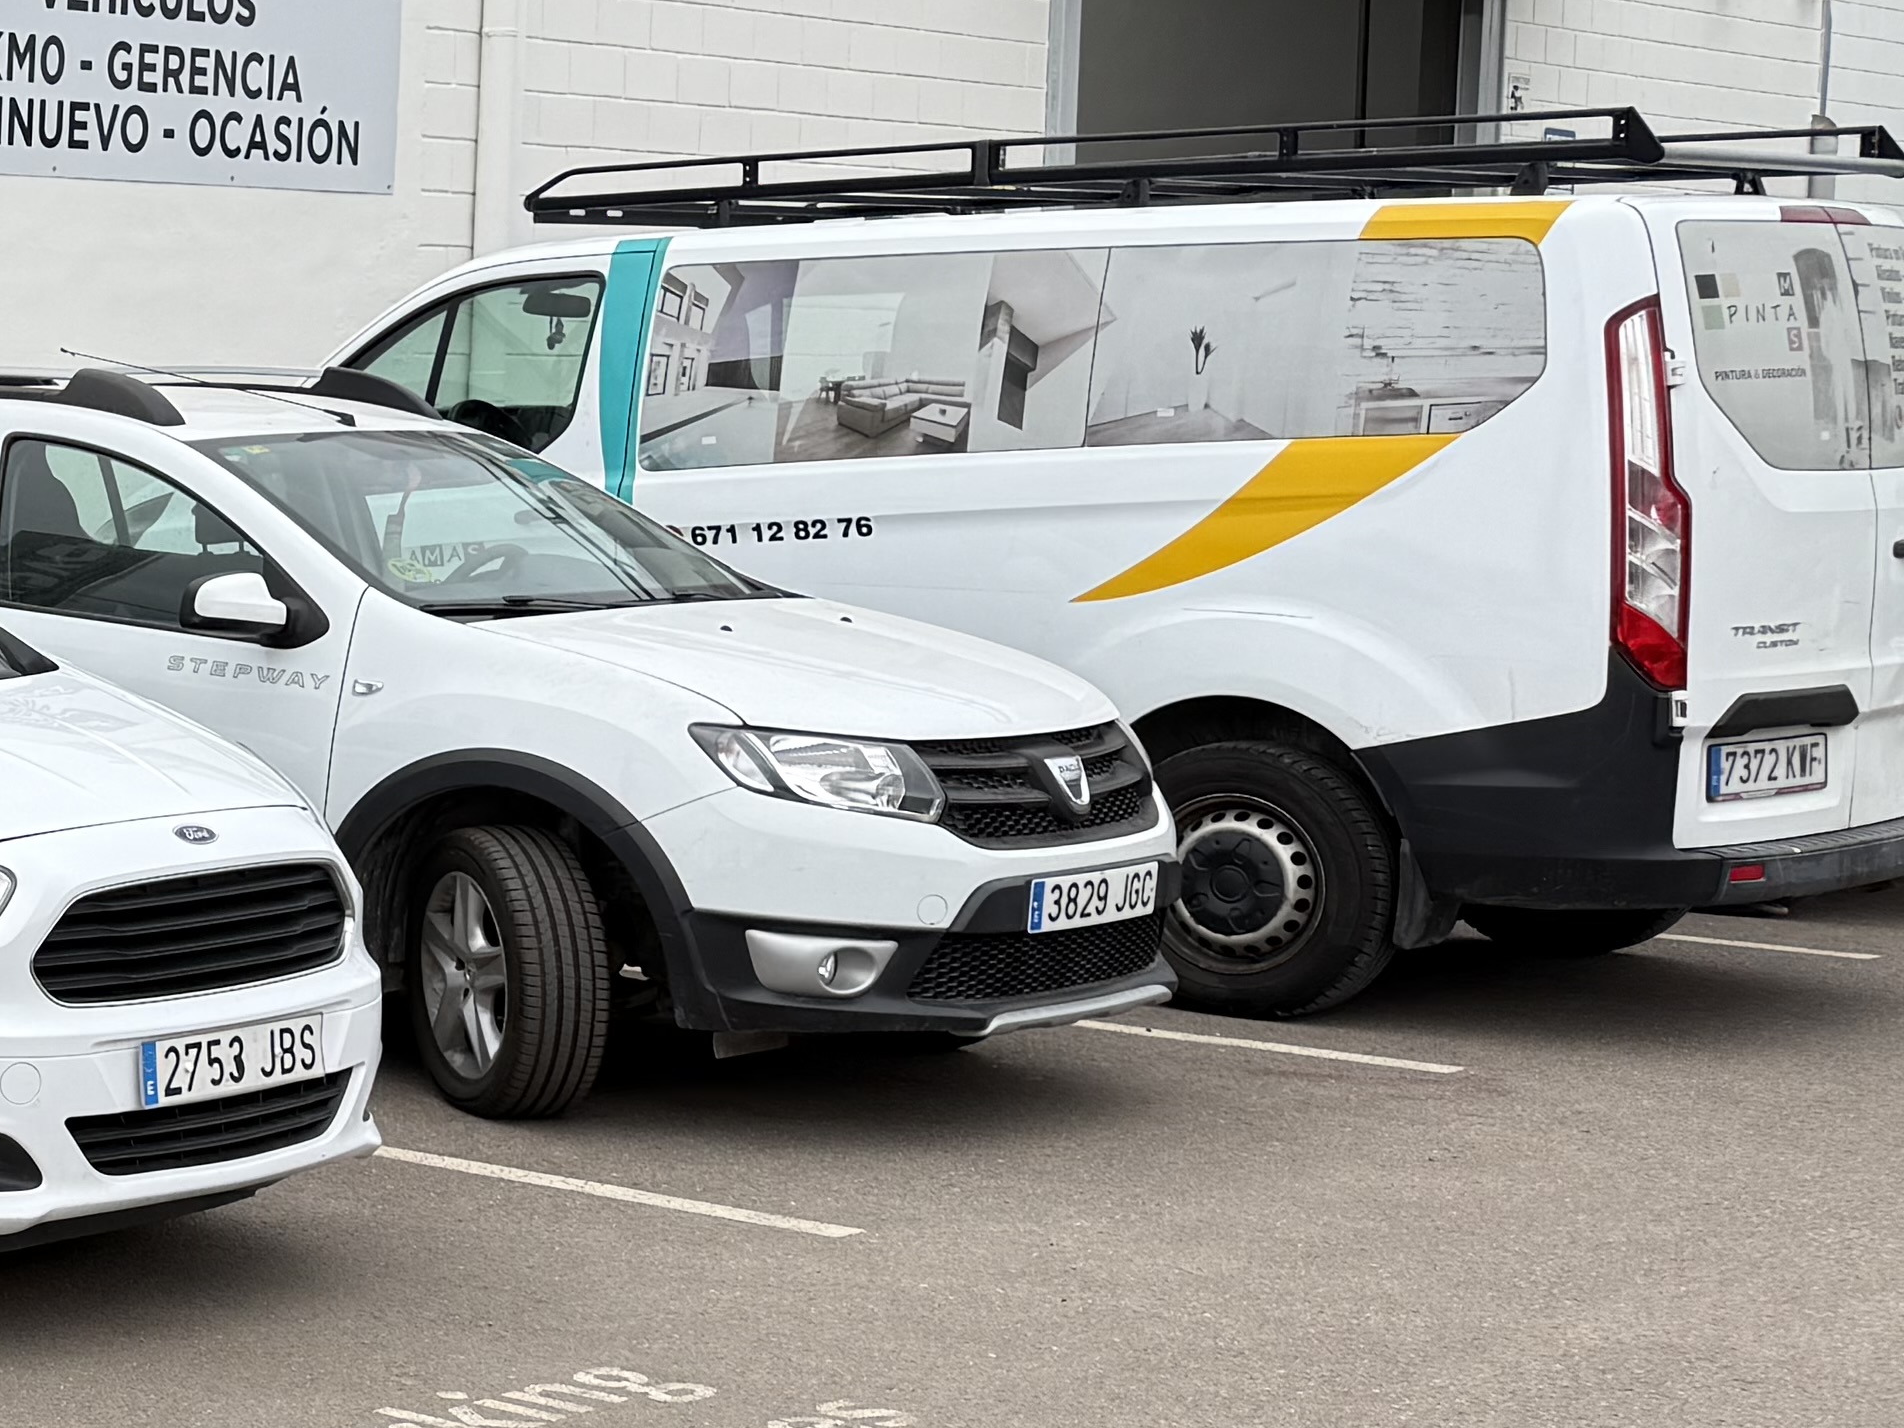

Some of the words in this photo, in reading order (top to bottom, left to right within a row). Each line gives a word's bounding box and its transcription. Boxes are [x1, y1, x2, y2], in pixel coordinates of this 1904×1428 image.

[107, 41, 303, 103] GERENCIA
[188, 106, 360, 166] OCASIÓN
[1726, 303, 1799, 324] PINTA
[1714, 369, 1752, 382] PINTURA
[691, 524, 737, 546] 671
[751, 522, 784, 543] 12
[793, 519, 828, 540] 82
[837, 516, 873, 538] 76
[1731, 622, 1802, 637] TRANSIT
[166, 655, 330, 689] STEPWAY
[1725, 746, 1780, 787] 7372
[1786, 741, 1821, 780] KWF
[183, 827, 210, 840] Ford
[1048, 876, 1109, 923] 3829
[1115, 869, 1154, 914] JGC
[163, 1035, 246, 1098] 2753
[260, 1023, 317, 1078] JBS
